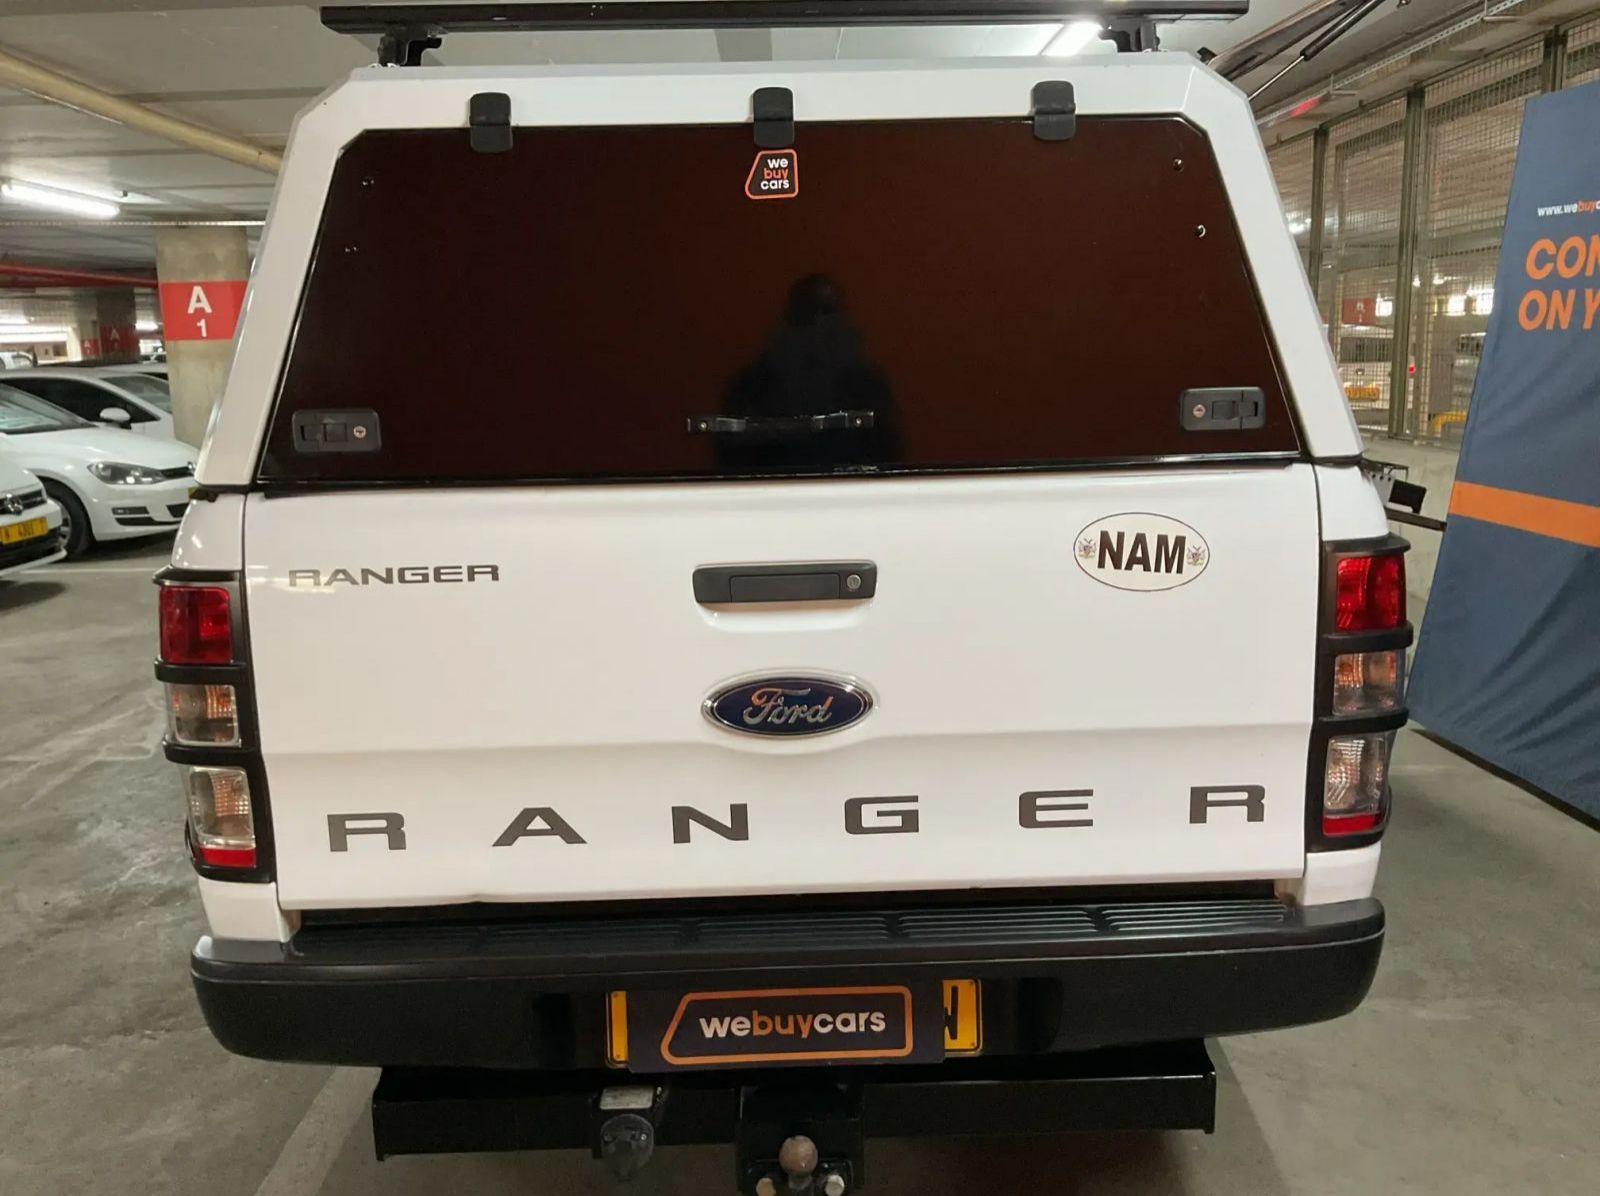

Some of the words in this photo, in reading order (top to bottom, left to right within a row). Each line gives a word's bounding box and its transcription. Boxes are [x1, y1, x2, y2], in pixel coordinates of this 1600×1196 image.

[763, 168, 789, 180] buy
[767, 158, 789, 169] we
[760, 180, 790, 190] cars
[187, 285, 213, 314] A
[1518, 288, 1577, 331] ON
[196, 318, 208, 337] 1
[1097, 530, 1187, 575] NAM
[288, 564, 500, 588] RANGER
[743, 687, 834, 725] Ford
[327, 784, 1266, 853] RANGER
[699, 1010, 887, 1039] webuycars
